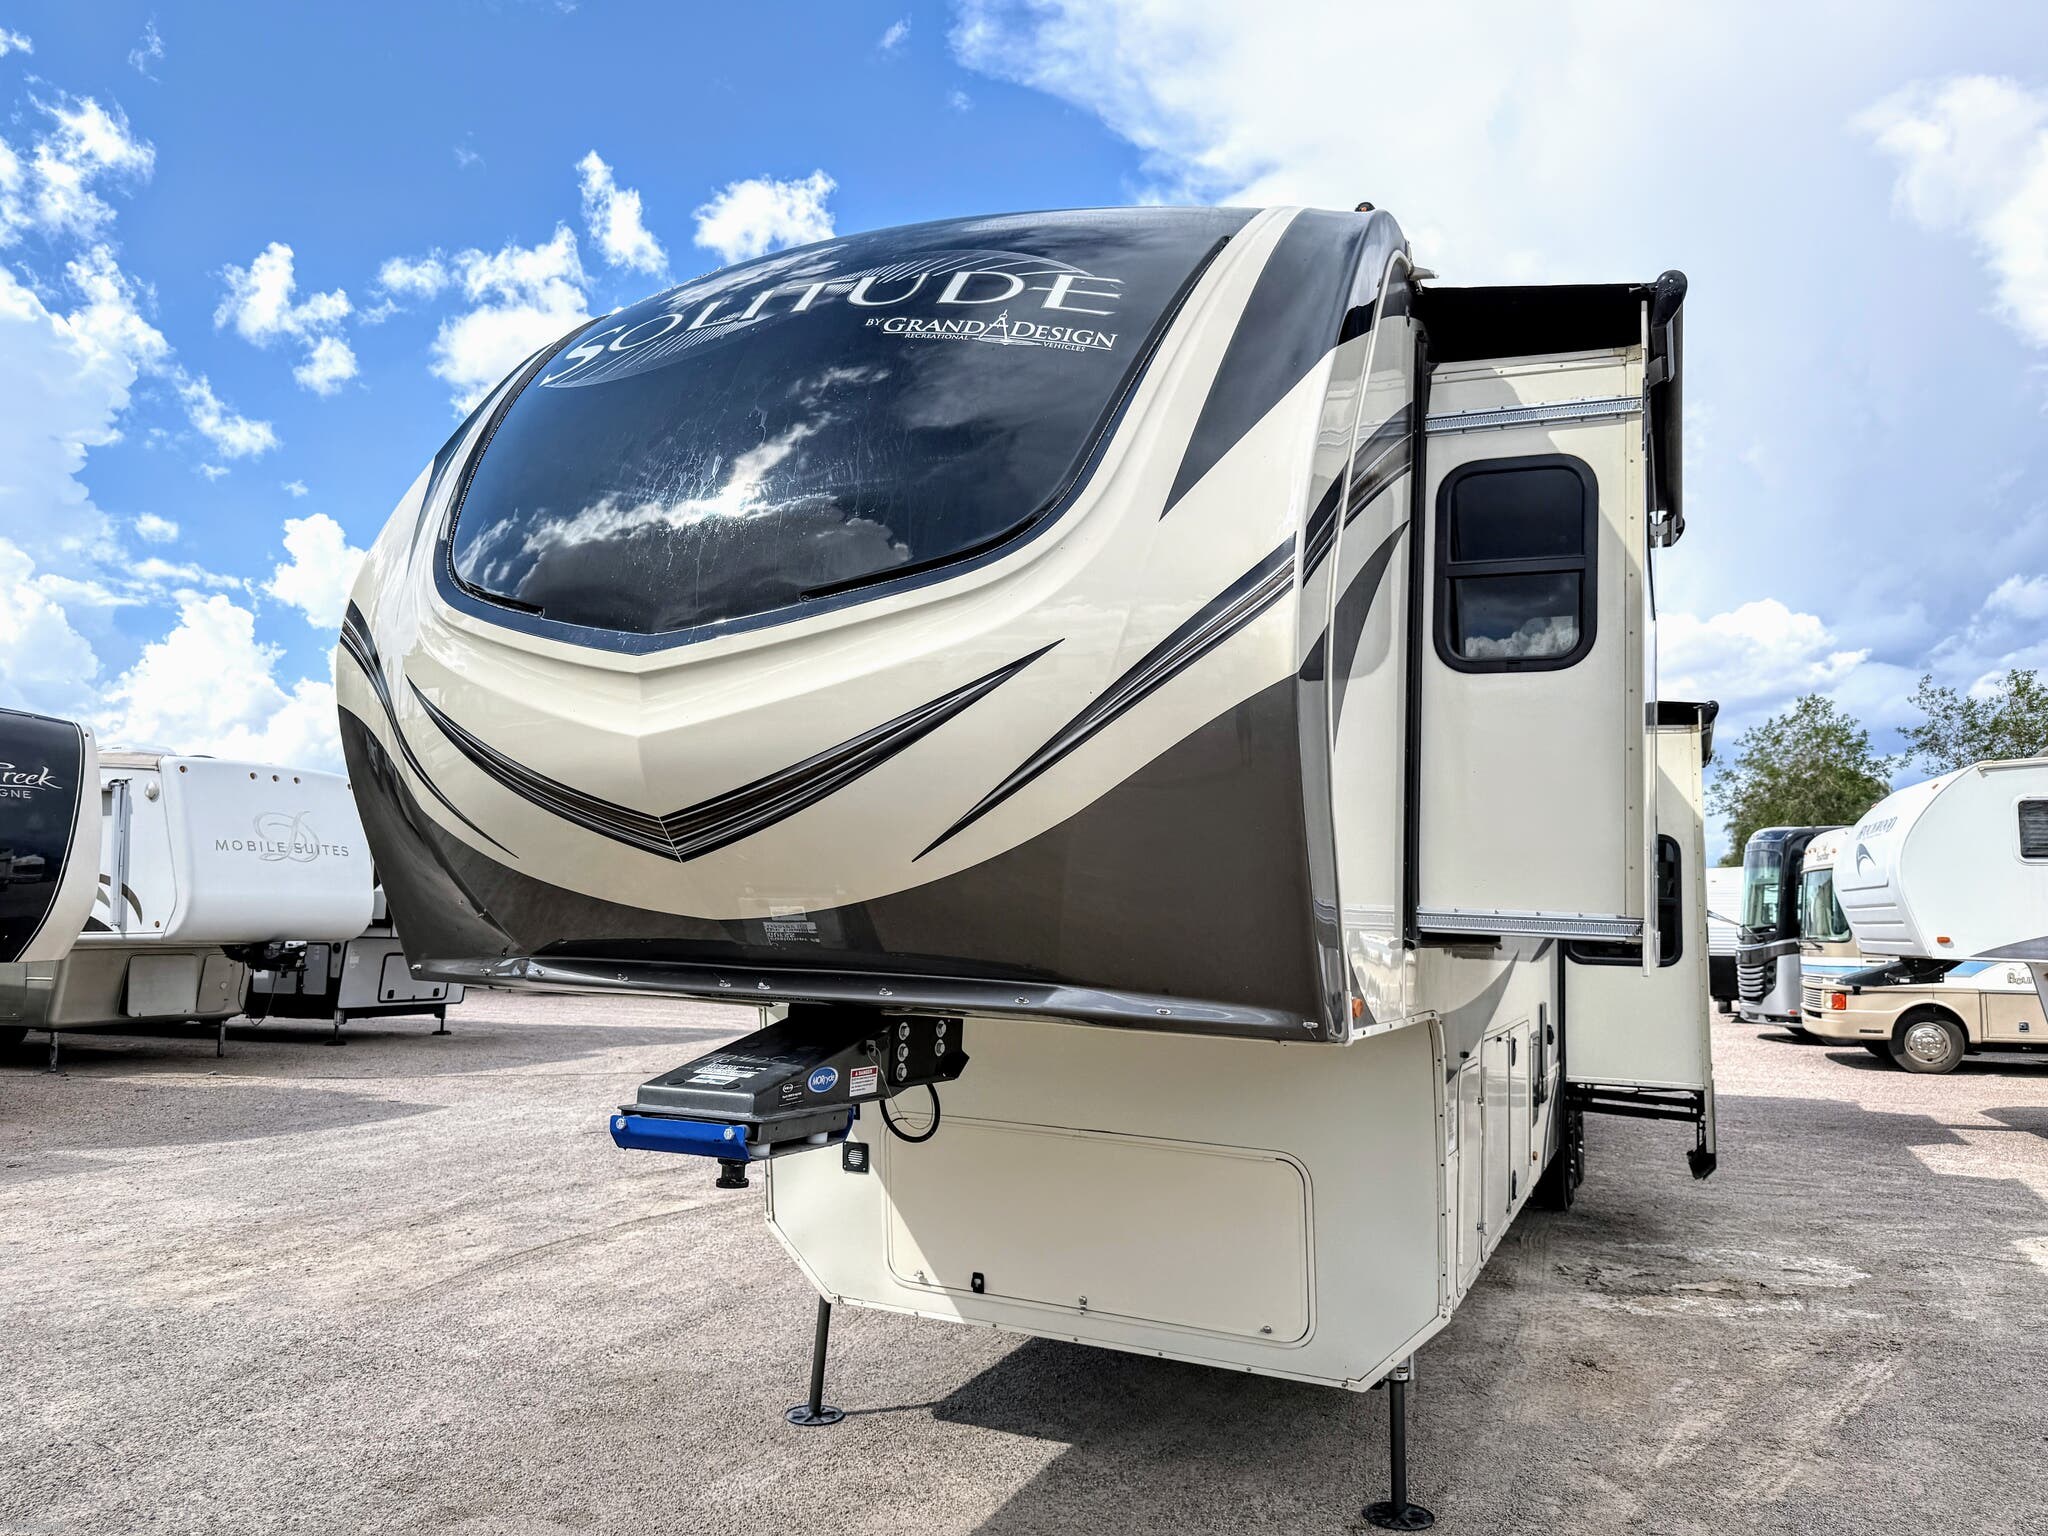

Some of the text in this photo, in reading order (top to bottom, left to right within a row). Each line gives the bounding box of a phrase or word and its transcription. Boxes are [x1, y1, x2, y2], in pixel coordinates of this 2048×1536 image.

[539, 271, 1125, 387] SOLITUDE
[865, 317, 1118, 349] BY GRAND DESIGN
[905, 332, 1086, 352] RECREATIONAL VEHICLES
[215, 839, 349, 857] MOBILE SUITES
